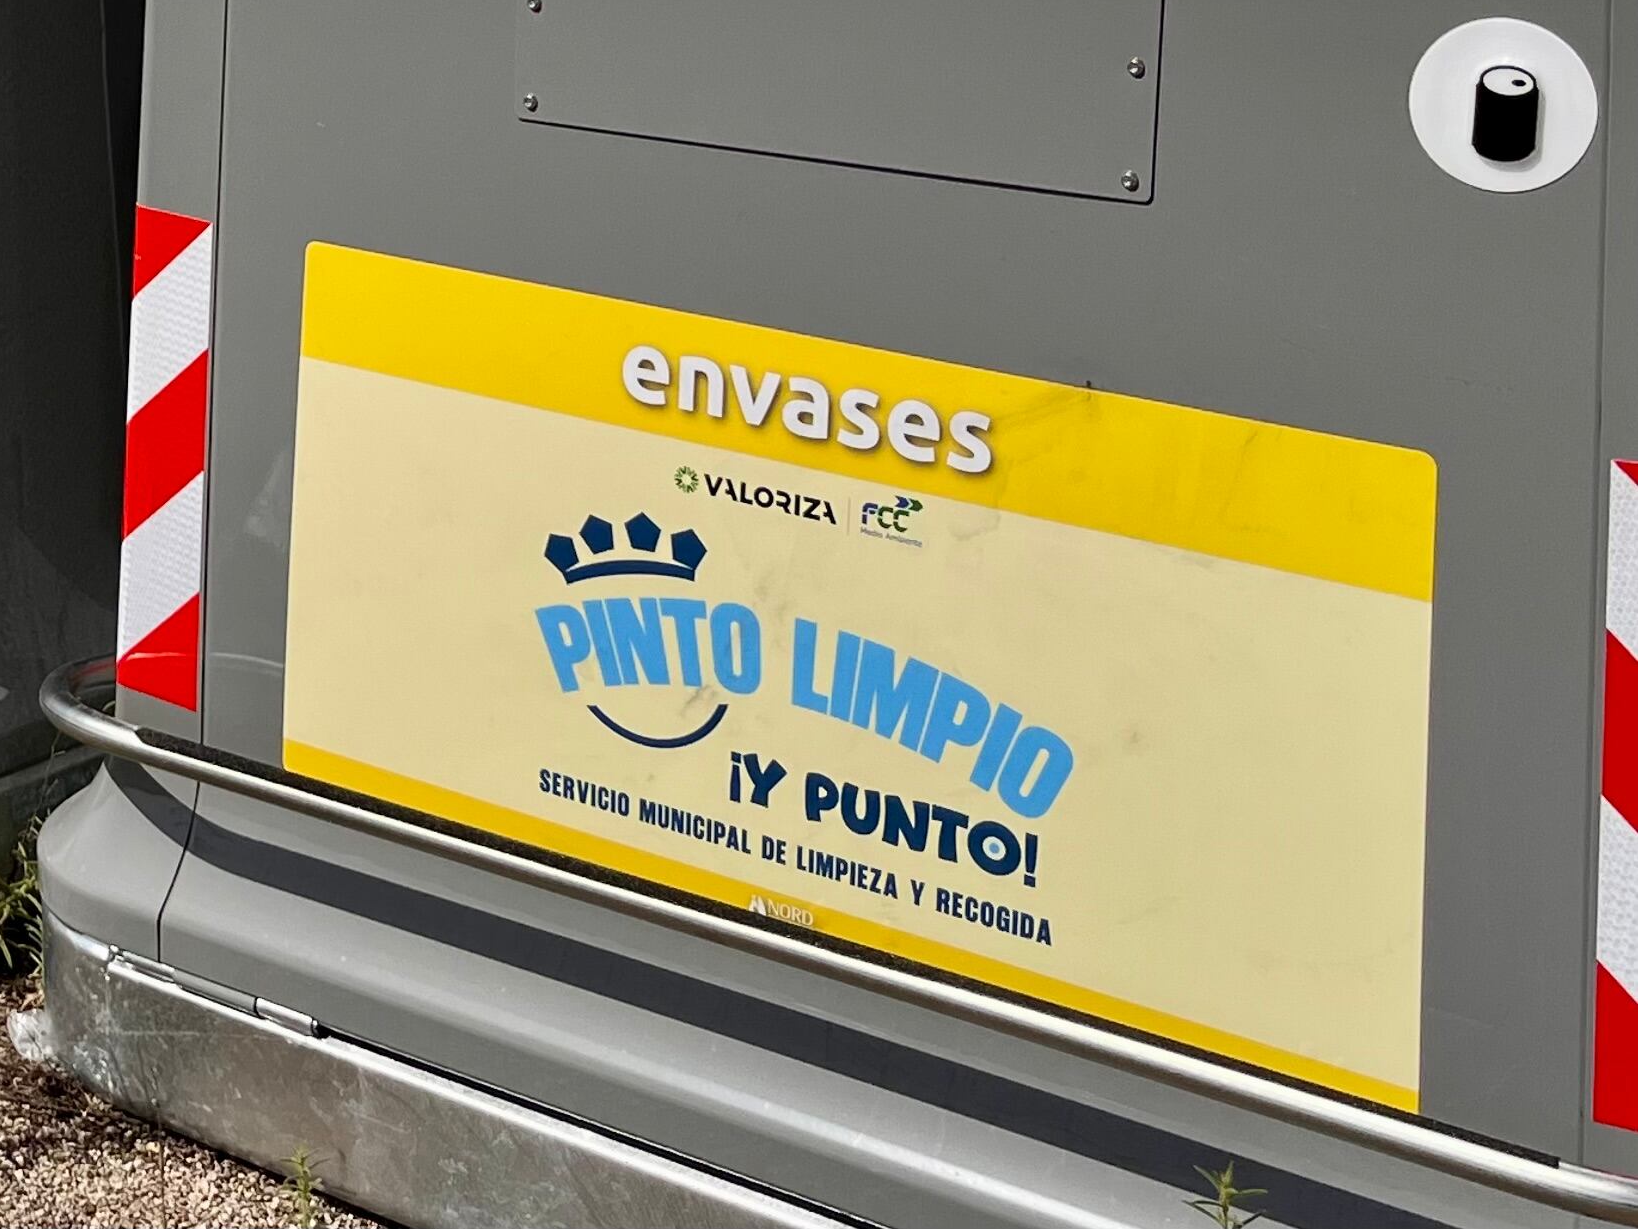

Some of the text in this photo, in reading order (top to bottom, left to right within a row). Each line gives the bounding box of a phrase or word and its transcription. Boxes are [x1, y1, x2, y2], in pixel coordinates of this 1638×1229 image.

[621, 344, 994, 475] envases
[704, 473, 837, 525] VALORIZA
[861, 502, 910, 533] FCC
[535, 596, 1075, 819] PINTO LIMPIO
[539, 769, 1053, 947] SERVICIO MUNICIPAL DE LIMPIEZA Y RECOGIDA
[805, 772, 1039, 887] PUNTO!
[766, 898, 814, 926] NORD
